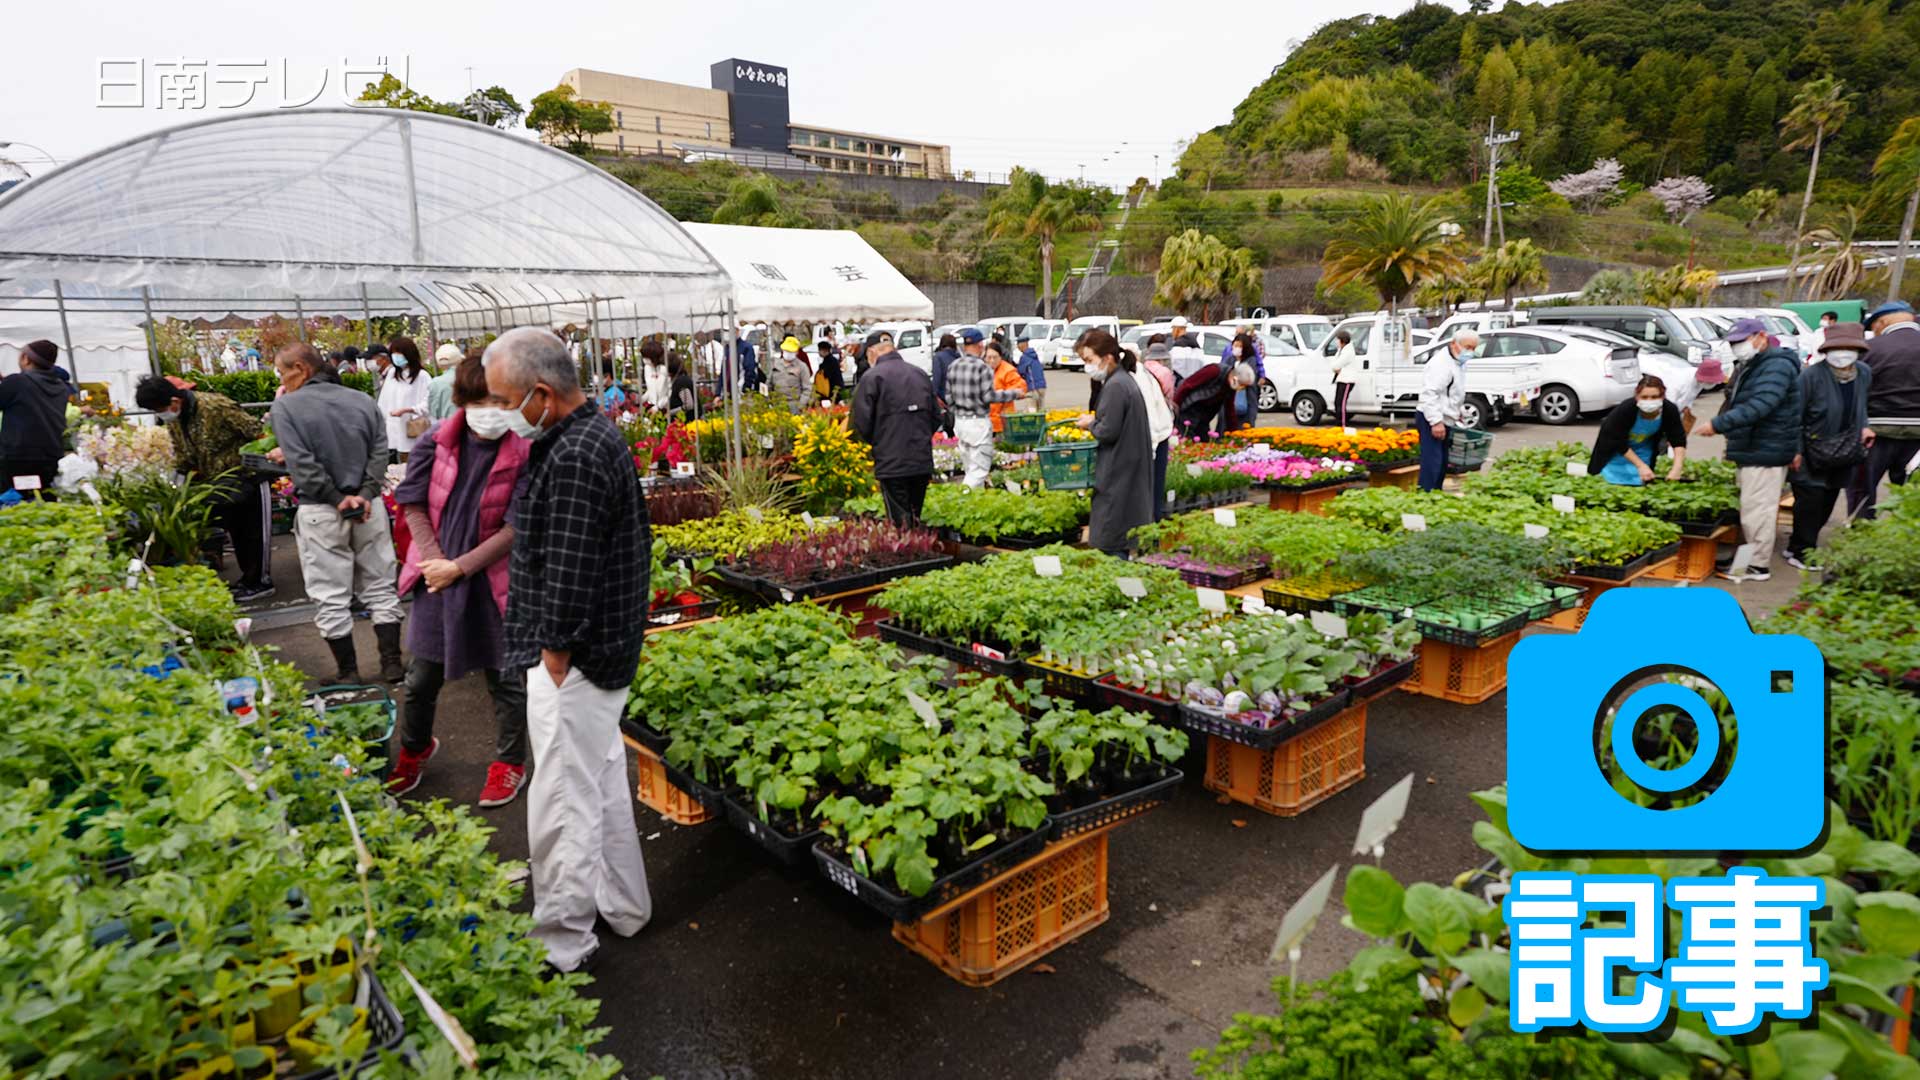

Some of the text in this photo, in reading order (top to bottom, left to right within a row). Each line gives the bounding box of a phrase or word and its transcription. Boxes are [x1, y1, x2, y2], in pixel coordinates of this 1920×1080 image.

[736, 65, 787, 87] ひなたの宿
